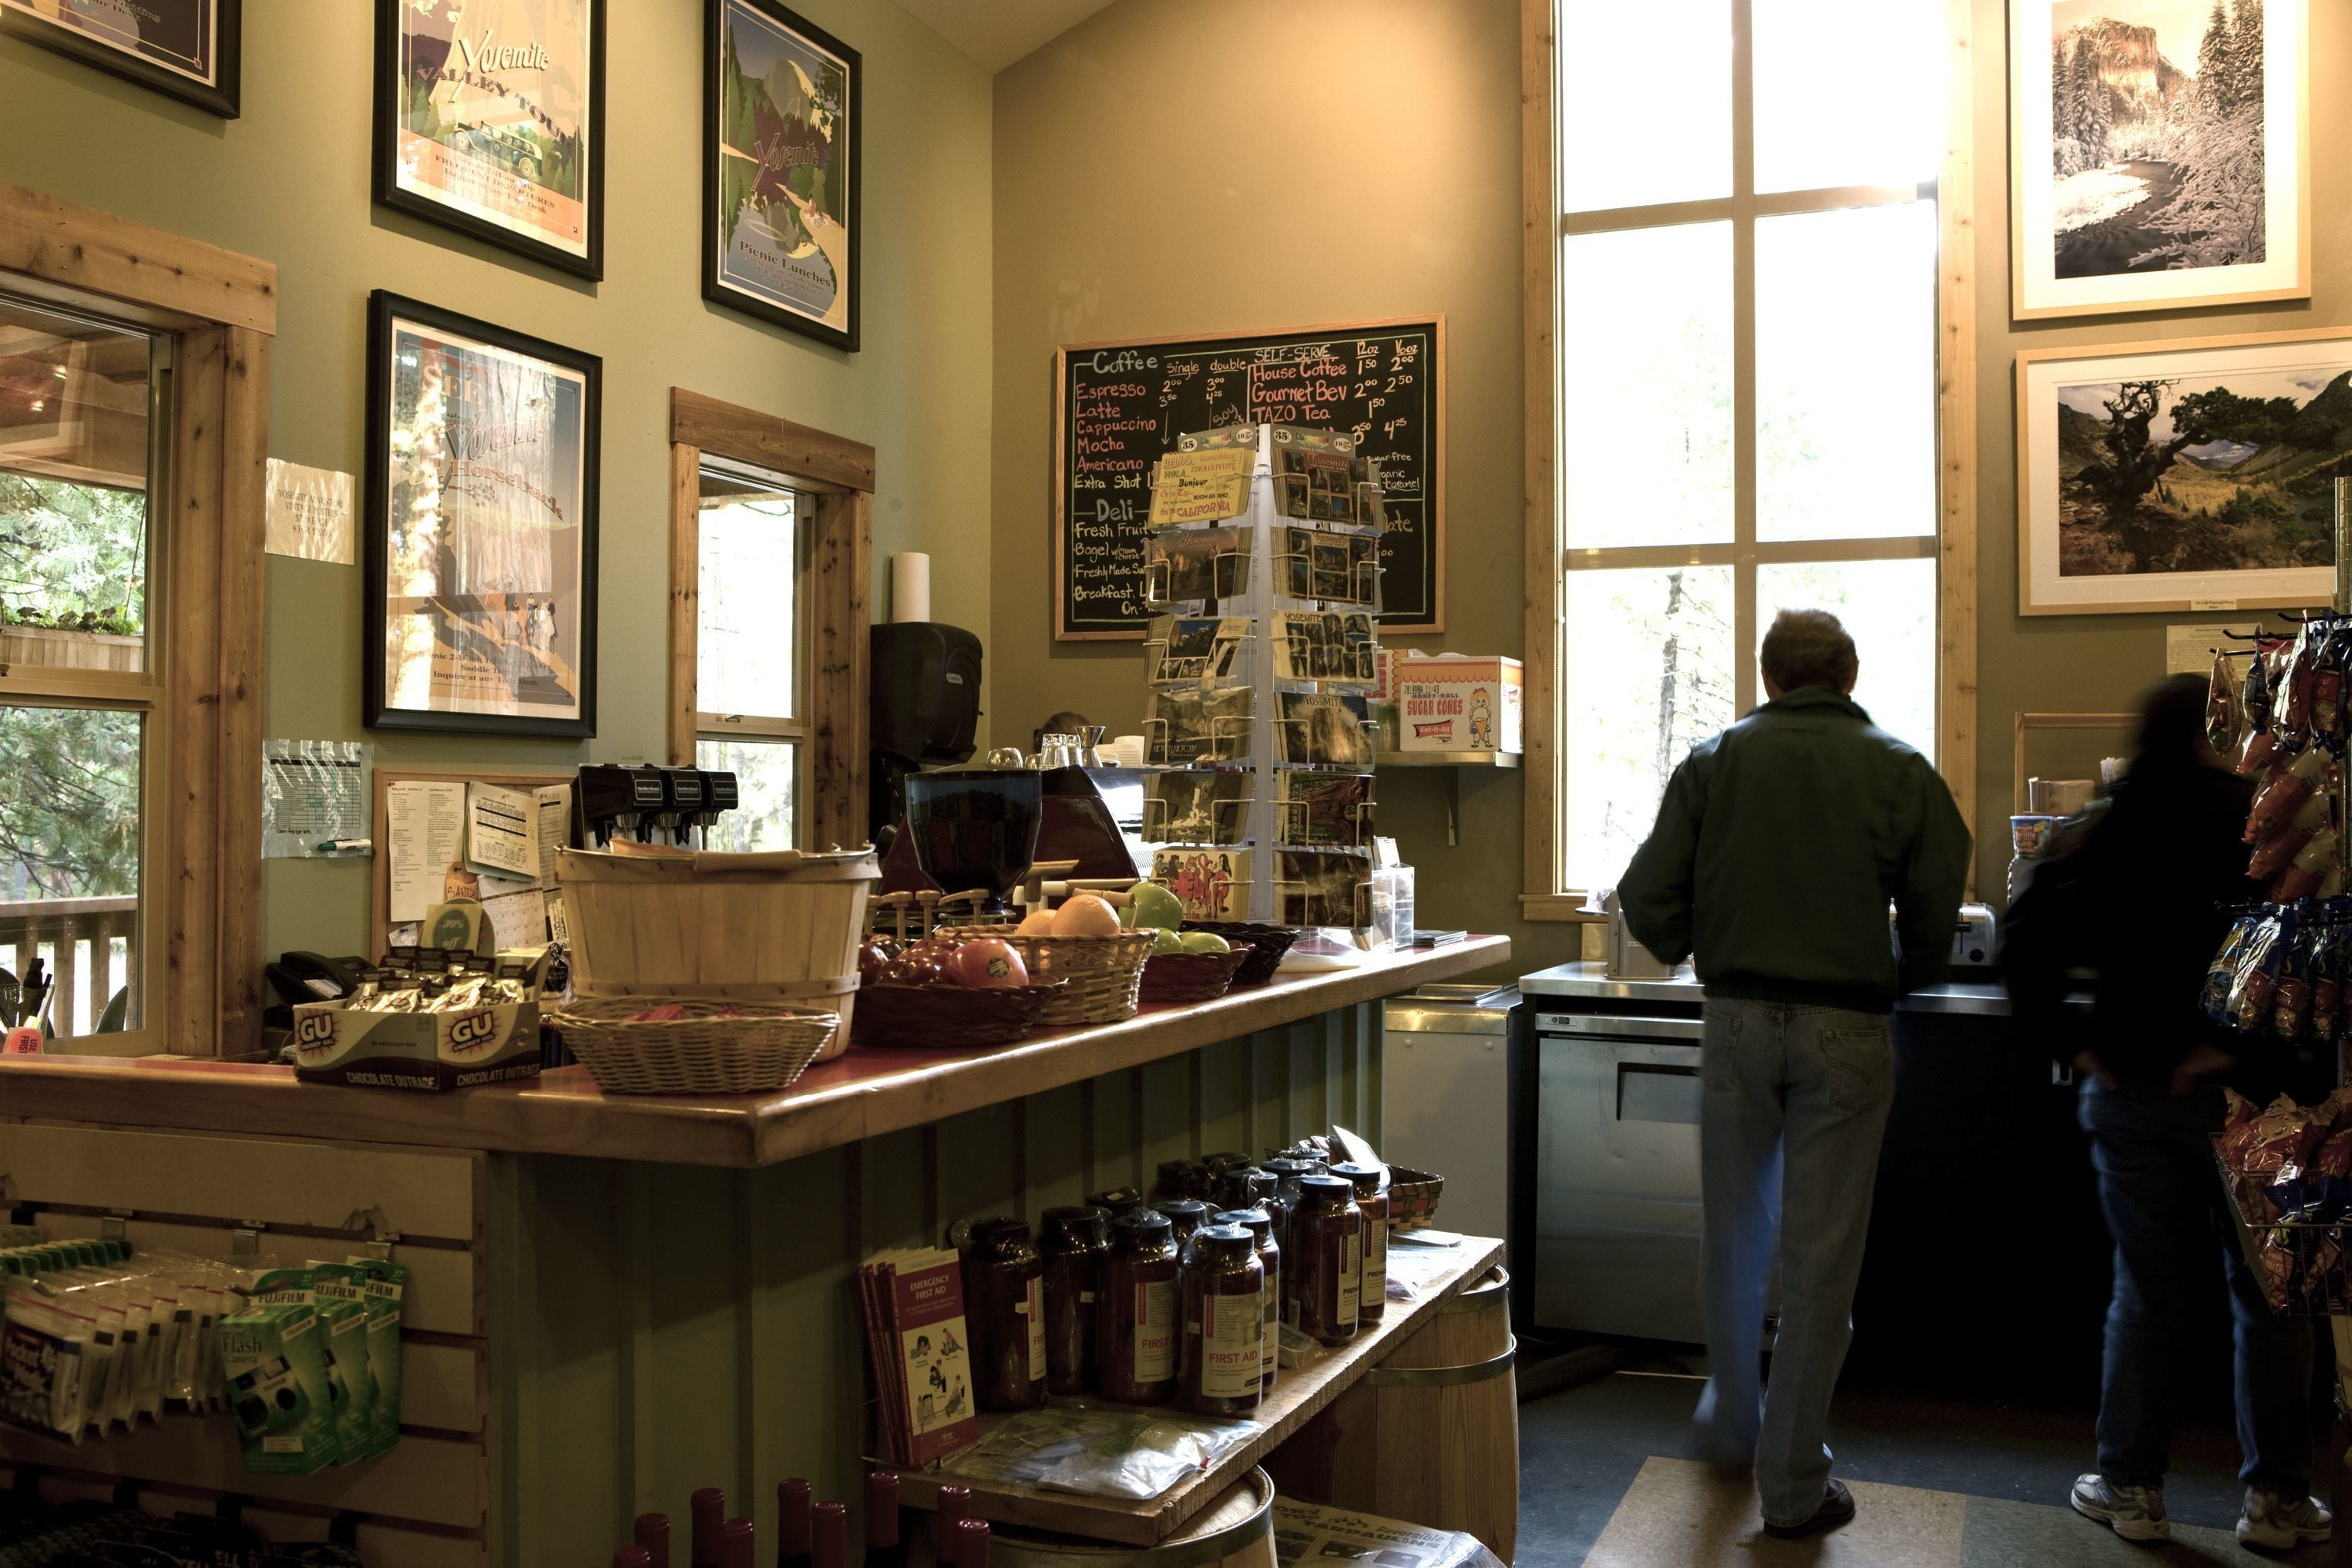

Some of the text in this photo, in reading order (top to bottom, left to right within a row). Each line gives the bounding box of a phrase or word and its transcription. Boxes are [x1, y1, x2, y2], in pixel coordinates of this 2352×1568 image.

[449, 29, 549, 103] Yosemite
[417, 67, 510, 99] VALLEY
[750, 132, 820, 193] Yosemite
[435, 154, 556, 208] FREQUENT DEPARTURES
[527, 200, 547, 213] Desk
[739, 240, 832, 287] Picnic Lunches
[1255, 339, 1418, 364] SELF-SERVE 12oz 16oz
[1093, 350, 1158, 374] Coffee
[1210, 358, 1247, 371] double
[1253, 363, 1296, 382] House
[1299, 358, 1347, 378] Coffee
[424, 365, 484, 405] SEE
[1076, 383, 1146, 400] Espresso
[1252, 381, 1315, 403] Gourmet
[1315, 380, 1347, 401] Bev
[1075, 401, 1121, 419] Latte
[1252, 405, 1296, 424] TAZO
[1302, 404, 1332, 421] Tea
[1076, 416, 1157, 436] Cappuccino
[439, 409, 544, 495] Yosemite
[1077, 437, 1125, 455] Mocha
[1076, 455, 1144, 473] Americano
[1307, 453, 1348, 468] Yosemite
[1074, 474, 1107, 489] Extra
[1114, 472, 1142, 489] Shot
[1178, 477, 1208, 488] Bonjour
[1386, 477, 1420, 490] caramel
[278, 489, 308, 502] YOSEITE
[450, 459, 564, 522] Horseback
[1096, 499, 1134, 522] Deli
[1177, 500, 1231, 517] CALIFORNIA
[1076, 520, 1148, 539] Fresh Fruit
[1178, 532, 1221, 547] Yosemite
[1075, 542, 1110, 563] Bagel
[1075, 563, 1132, 582] Freshly Made
[1285, 613, 1322, 623] YOSEMITE
[460, 664, 490, 673] Saddle
[433, 670, 465, 680] Inquire
[519, 677, 539, 686] Desk
[1407, 699, 1463, 716] SUGAR CONES
[447, 886, 475, 898] SAND
[443, 937, 461, 950] off
[298, 1012, 333, 1043] GU
[451, 1010, 494, 1043] GU
[29, 1039, 38, 1053] USE
[301, 1040, 321, 1051] ENERGY
[453, 1033, 496, 1052] ENERGY GEL
[347, 1072, 435, 1089] CHOCOLATE OUTRAGE
[457, 1063, 541, 1087] CHOCOLATE OUTRAGE
[909, 1274, 949, 1291] EMERGENCY
[259, 1292, 305, 1303] FUJIFILM
[316, 1284, 357, 1299] UJIFILM
[916, 1285, 946, 1301] FIRST AID
[286, 1318, 312, 1337] FUJIFILM
[336, 1315, 362, 1332] FUJIFILM
[371, 1314, 396, 1329] FUJIFILM
[223, 1335, 262, 1354] Flash
[1142, 1338, 1168, 1348] FIRST
[225, 1355, 257, 1364] Camera
[1209, 1350, 1258, 1363] FIRST AID
[1274, 1505, 1321, 1516] DRY
[1303, 1519, 1440, 1548] TARPAULINS
[1376, 1526, 1444, 1542] Reversible
